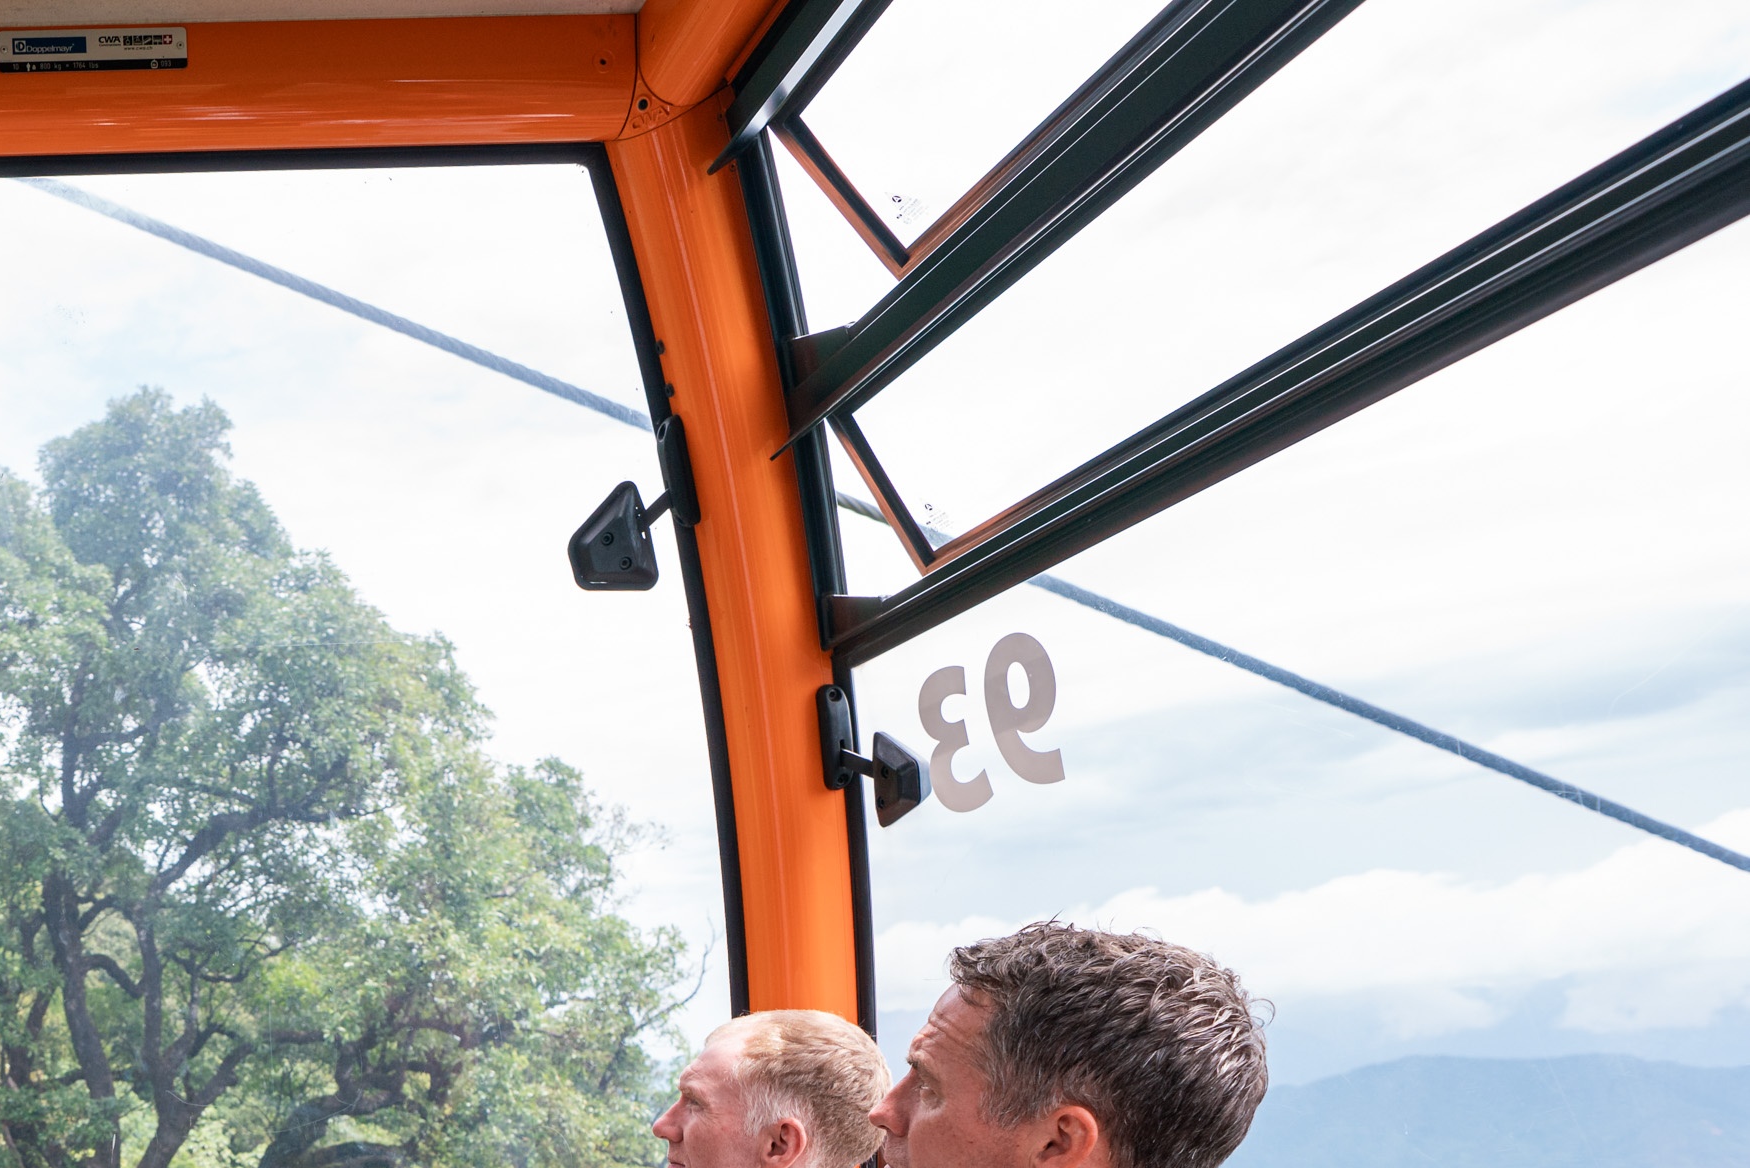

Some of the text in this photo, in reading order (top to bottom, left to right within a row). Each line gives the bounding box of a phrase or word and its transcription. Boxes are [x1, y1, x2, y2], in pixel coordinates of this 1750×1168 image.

[98, 35, 121, 43] CWA
[26, 44, 73, 54] Doppelmayr
[39, 62, 51, 70] 800
[53, 62, 62, 71] kg
